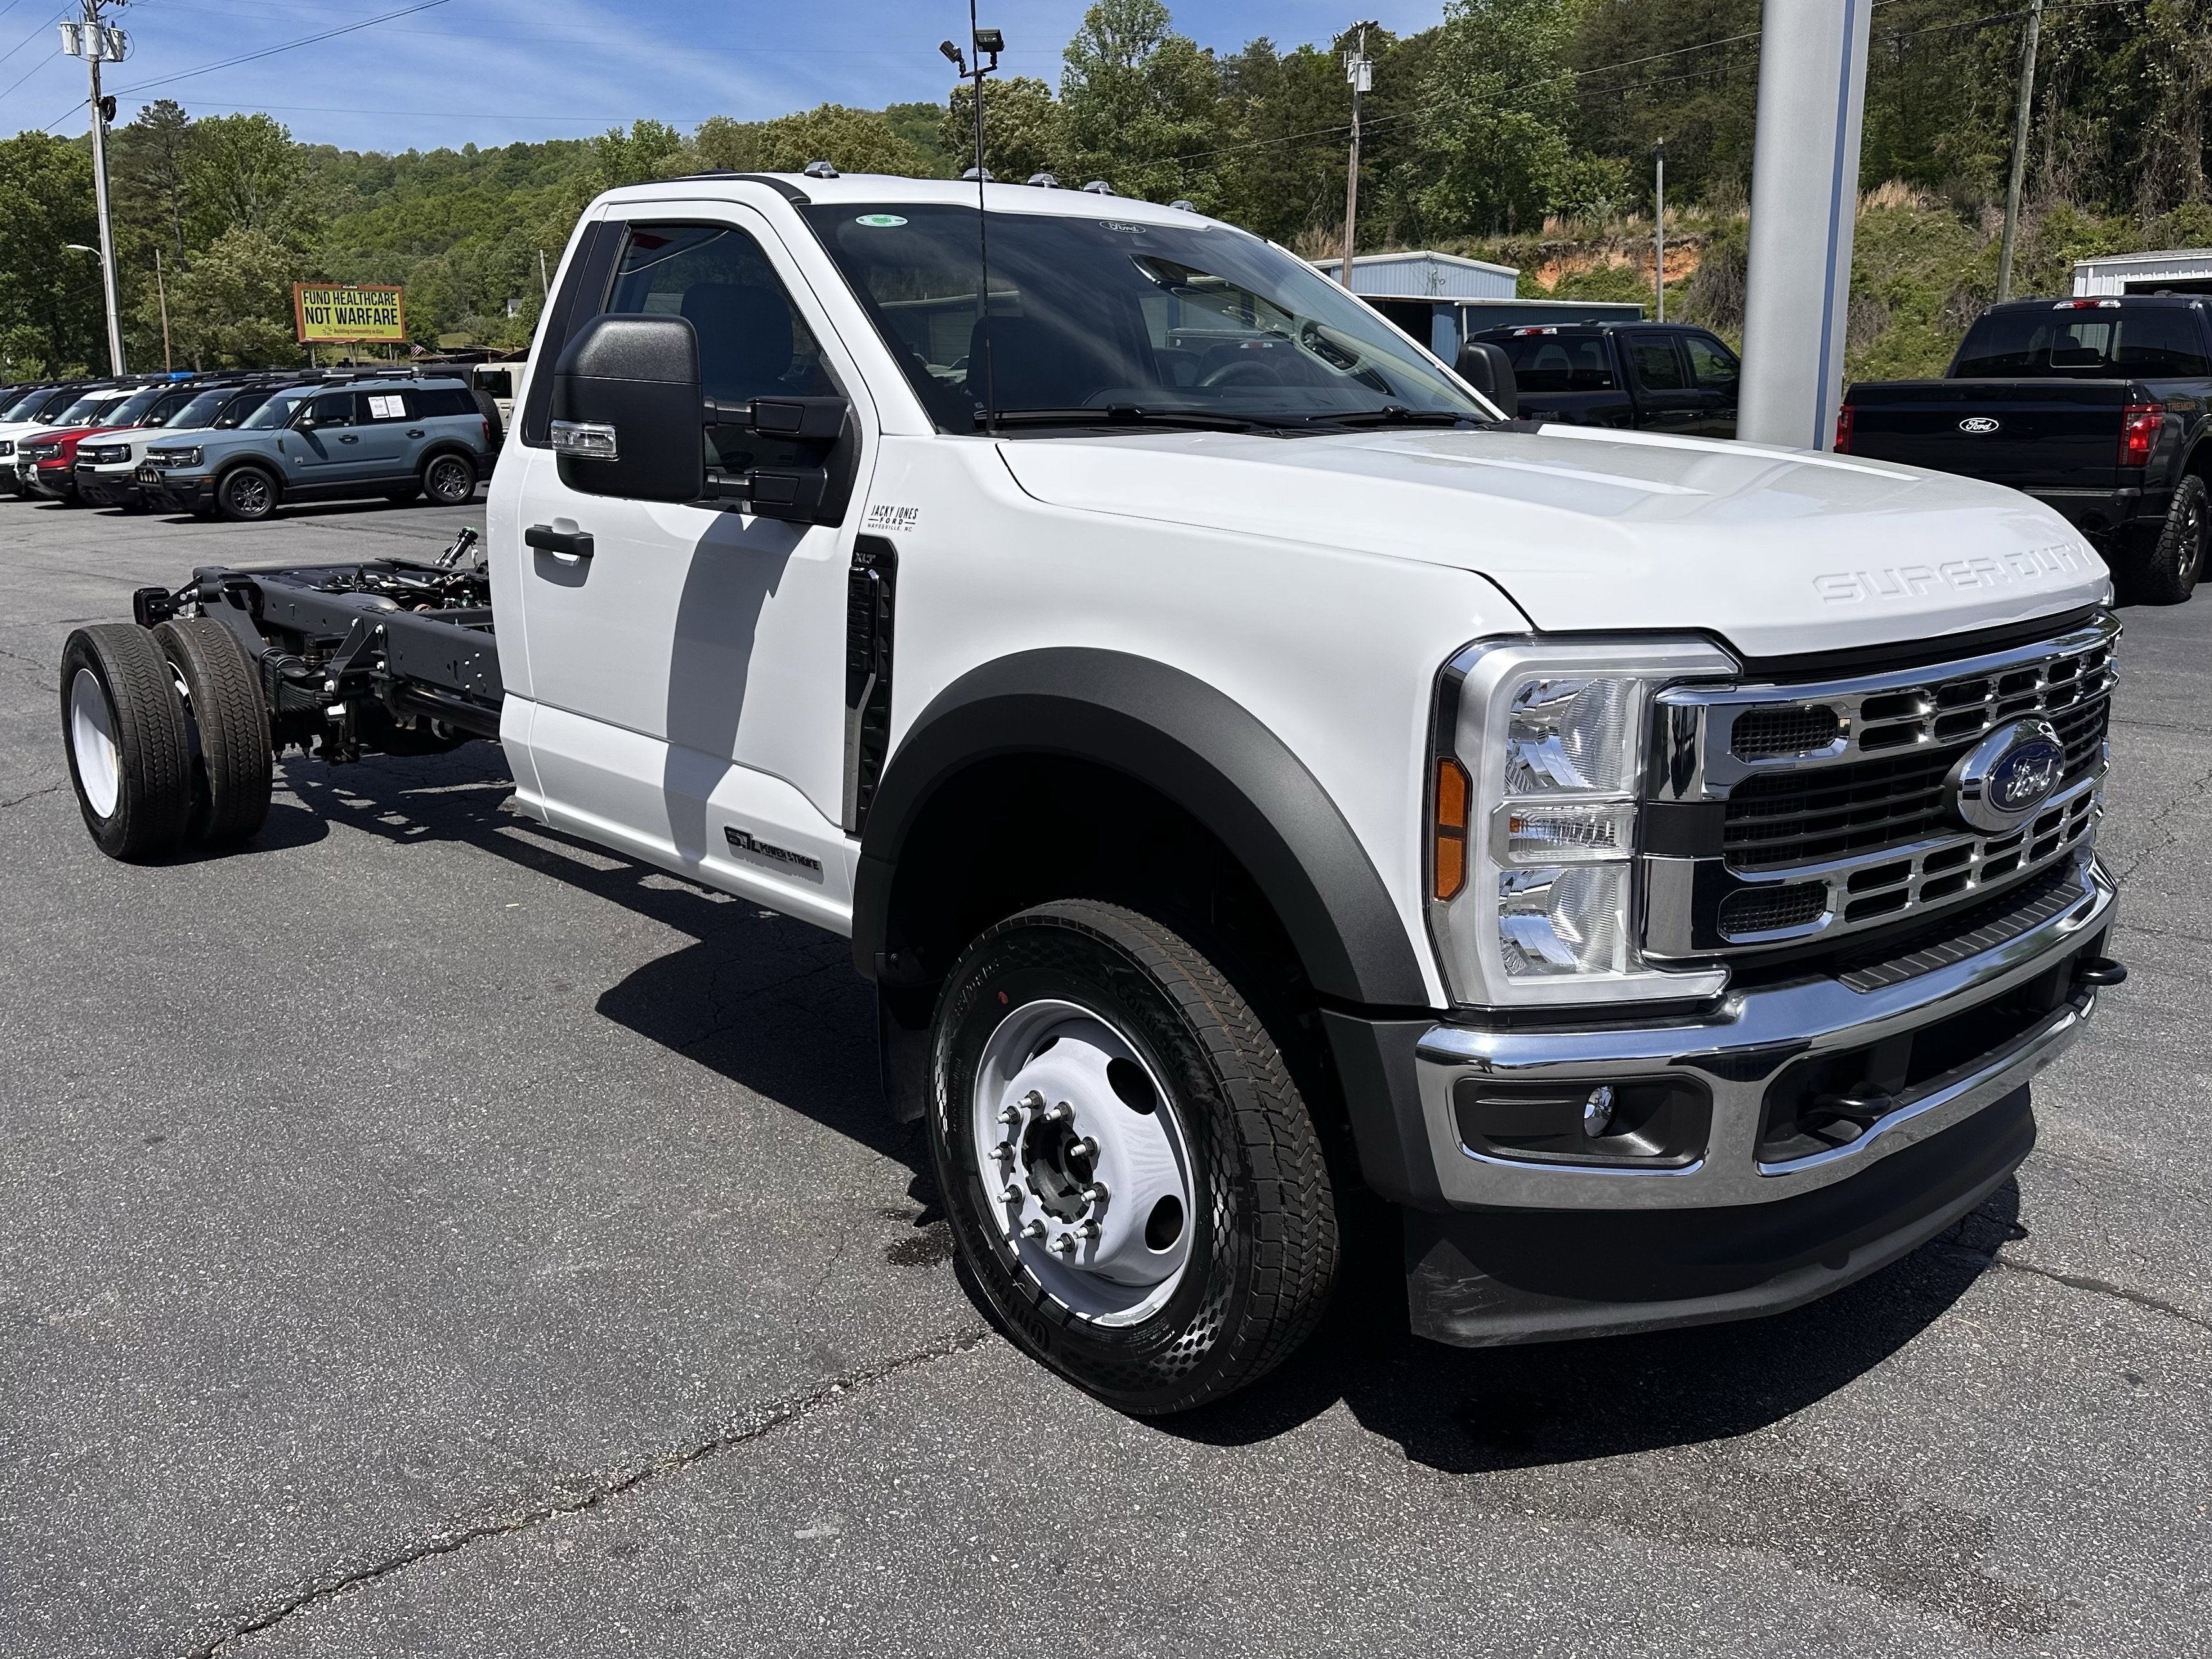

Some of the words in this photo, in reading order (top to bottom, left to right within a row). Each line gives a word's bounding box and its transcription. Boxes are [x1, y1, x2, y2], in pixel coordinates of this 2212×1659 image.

[1109, 221, 1138, 231] Ford
[303, 291, 330, 305] FUND
[333, 292, 397, 306] HEALTHCARE
[305, 307, 331, 324] NOT
[334, 307, 398, 325] WARFARE
[2167, 402, 2195, 412] TREMOR
[1965, 420, 1992, 430] Ford
[871, 505, 895, 518] JACKY
[895, 507, 919, 520] JONES
[854, 552, 876, 564] XLT
[1812, 558, 2008, 605] SUPER
[2005, 541, 2092, 577] DUTY
[2005, 750, 2052, 802] Ford
